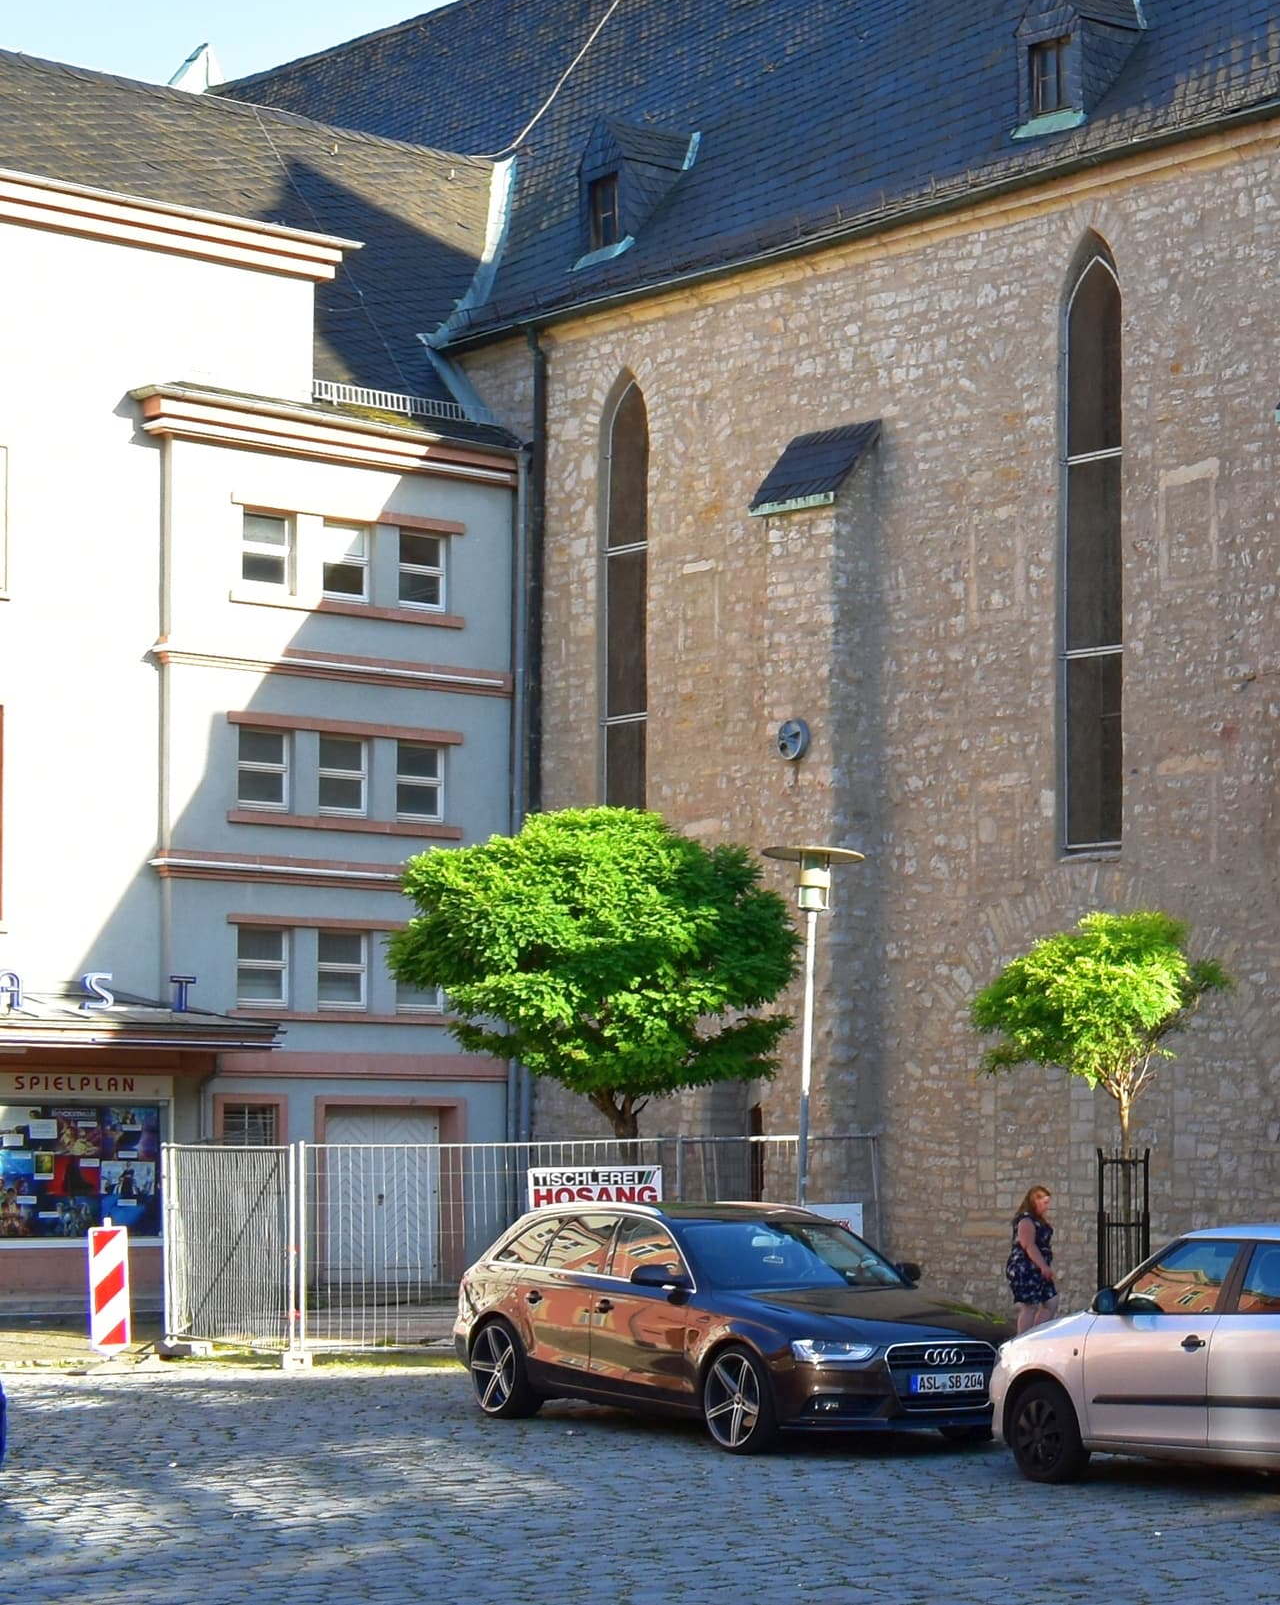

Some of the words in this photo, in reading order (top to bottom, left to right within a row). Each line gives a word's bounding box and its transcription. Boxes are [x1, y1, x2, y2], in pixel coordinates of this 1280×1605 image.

[15, 1076, 135, 1092] SPIELPLAN
[534, 1171, 639, 1186] TISCHLEREI
[533, 1186, 658, 1208] HOSANG
[919, 1376, 940, 1390] ASL
[948, 1375, 962, 1389] SB
[964, 1374, 983, 1389] 204
